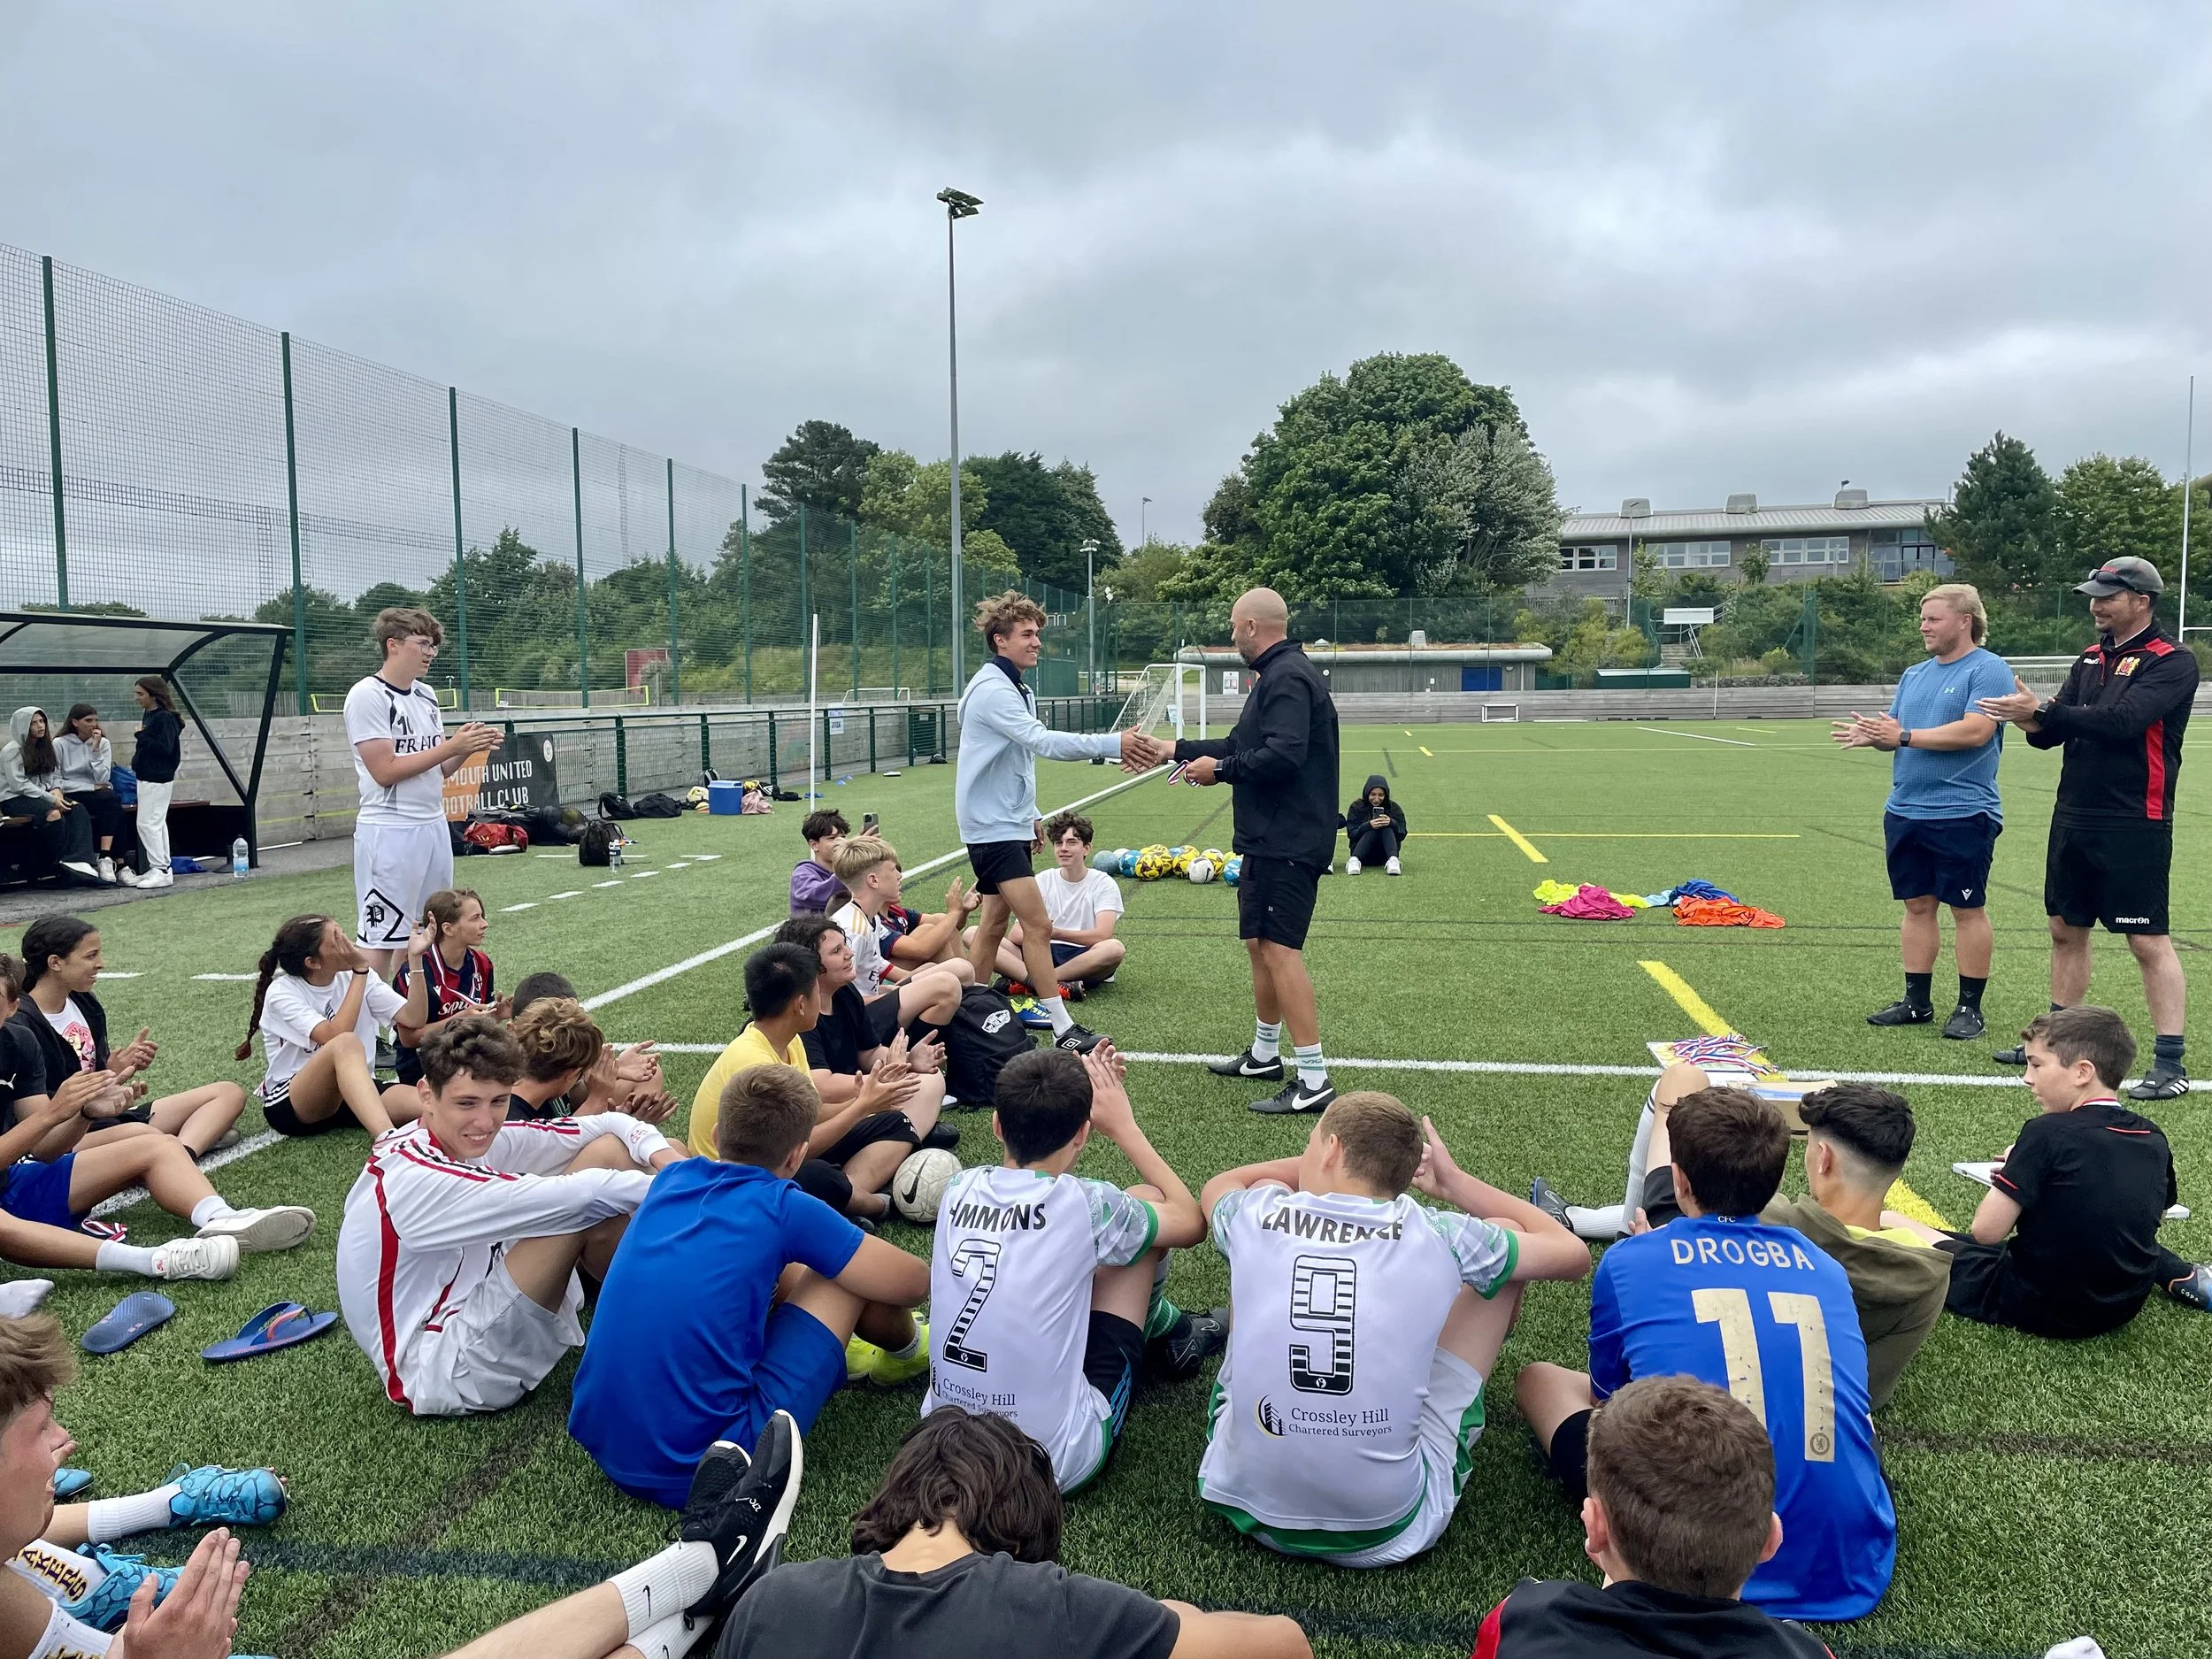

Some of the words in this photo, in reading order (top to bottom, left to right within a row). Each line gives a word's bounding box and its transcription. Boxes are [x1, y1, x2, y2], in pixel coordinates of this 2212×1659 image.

[492, 759, 533, 782] UNITED
[442, 790, 492, 815] OOTBALL
[497, 786, 529, 807] CLUB
[1670, 1237, 1816, 1271] DROGBA
[943, 1238, 1002, 1373] 2
[1288, 1254, 1357, 1396] 9
[1691, 1287, 1835, 1463] 11
[943, 1378, 988, 1406] Crossley
[991, 1394, 1017, 1406] Hill
[1288, 1423, 1340, 1437] Chartered
[1341, 1425, 1392, 1438] Surveyors
[1291, 1407, 1357, 1427] Crossley
[1362, 1408, 1389, 1424] Hill
[14, 1548, 87, 1602] AKERS
